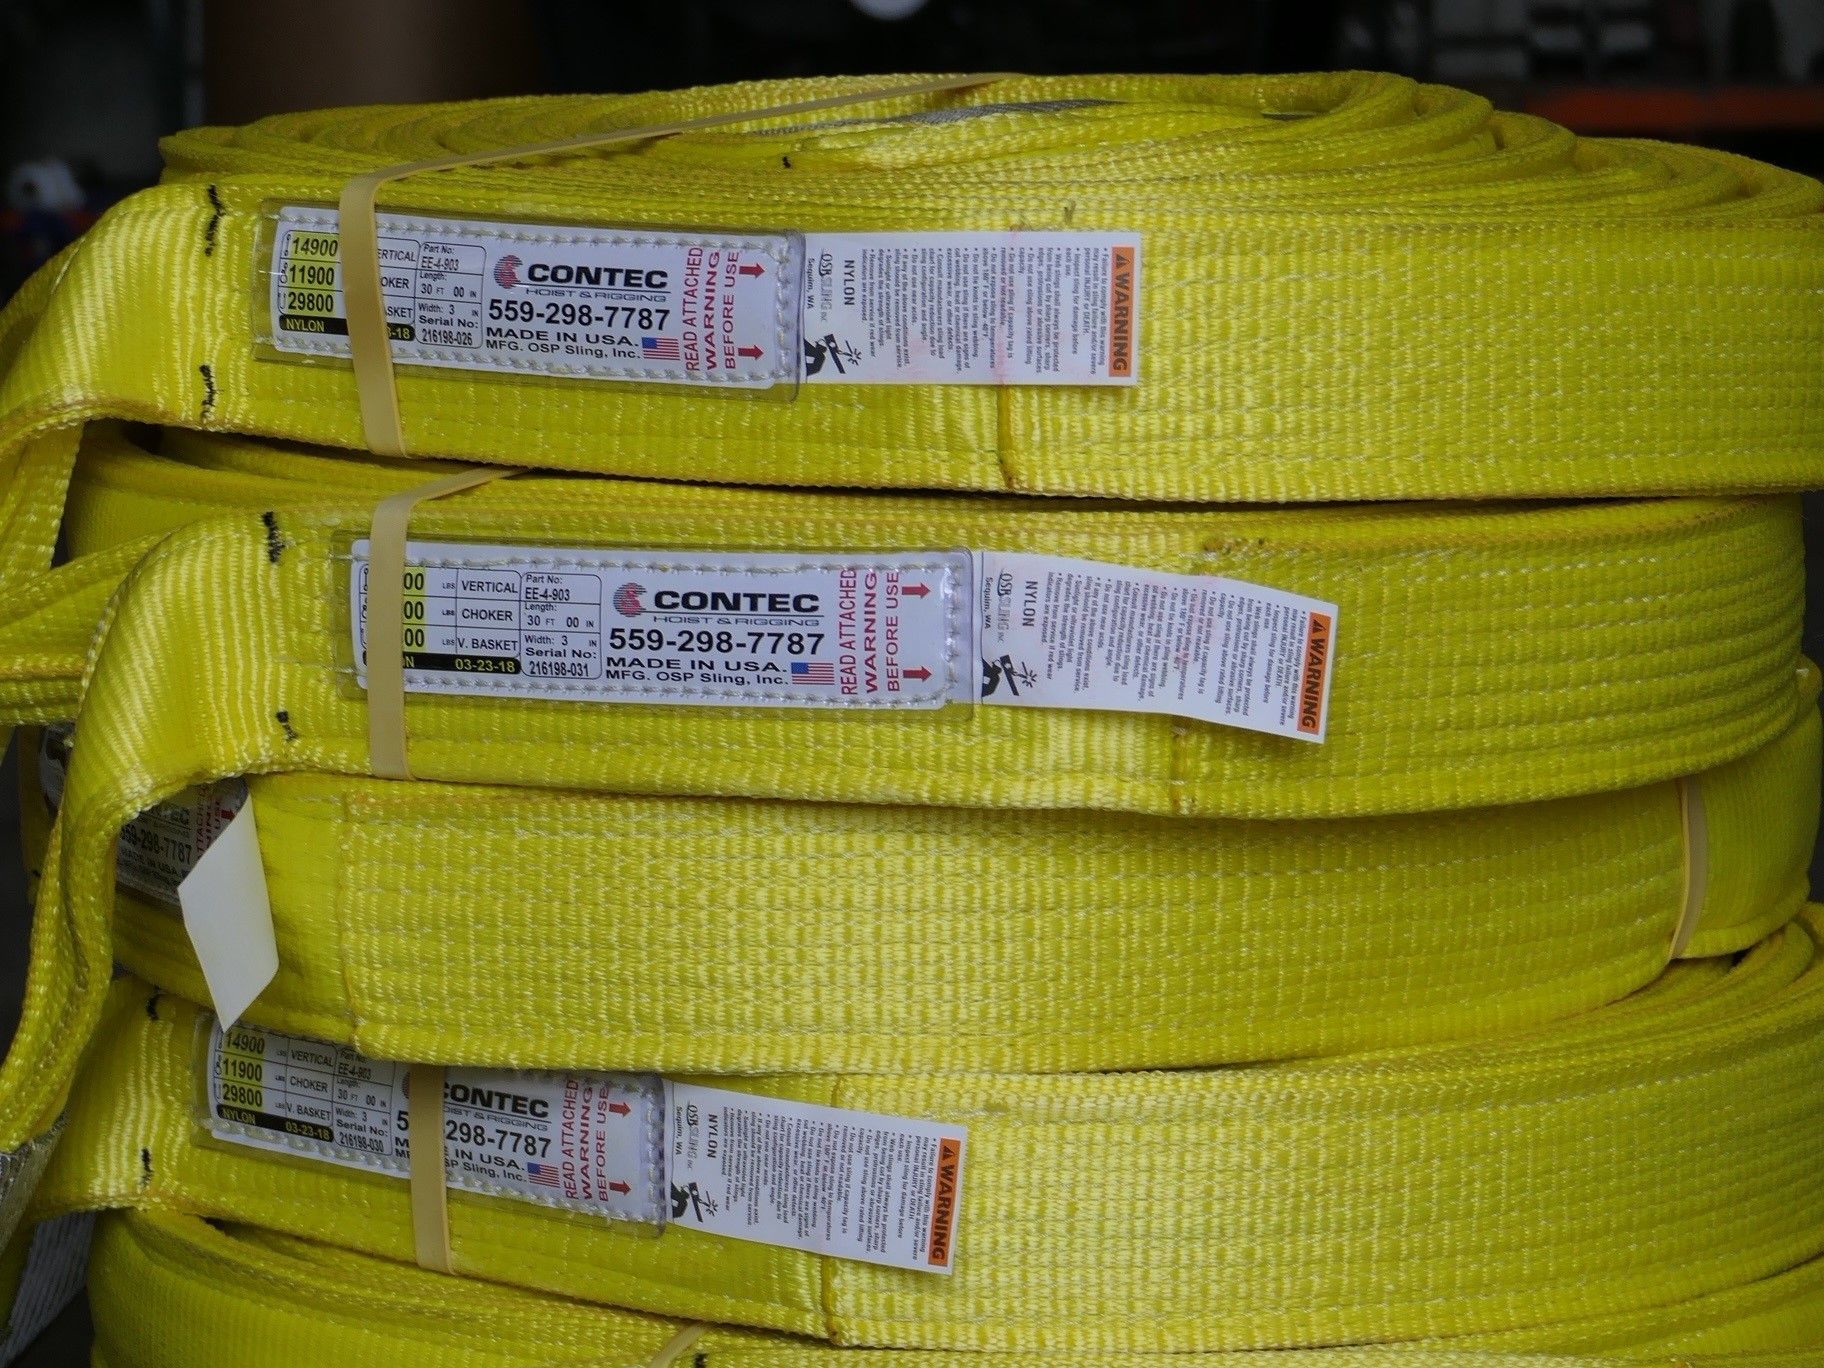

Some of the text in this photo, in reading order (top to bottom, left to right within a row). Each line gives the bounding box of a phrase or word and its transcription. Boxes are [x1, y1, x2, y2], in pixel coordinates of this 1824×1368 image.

[292, 236, 338, 257] 14900
[421, 256, 459, 271] EE-4-903
[289, 264, 334, 286] 11900
[527, 263, 668, 289] CONTEC
[843, 259, 855, 306] NYLON
[288, 292, 334, 312] 29800
[681, 247, 703, 372] READ ATTACHED
[704, 251, 720, 370] WARNING
[722, 251, 739, 369] BEFORE USE
[419, 315, 478, 329] Serial No:
[489, 298, 670, 331] 559-298-7787
[1113, 272, 1132, 371] WARNING
[285, 318, 325, 332] NYLON
[422, 328, 472, 346] 216198-026
[486, 327, 639, 347] MADE IN USA.
[486, 339, 520, 351] MFG.
[528, 341, 560, 354] OSP
[613, 348, 641, 359] Inc.
[461, 580, 518, 594] VERTICAL
[526, 574, 562, 584] Part No:
[525, 587, 570, 601] EE-4-903
[654, 590, 819, 613] CONTEC
[1022, 581, 1037, 627] NYLON
[461, 608, 513, 622] CHOKER
[524, 603, 557, 612] Length:
[527, 614, 579, 628] 30 00
[653, 615, 819, 627] HOIST RIGGING
[838, 567, 858, 695] READ ATTACHED
[524, 634, 554, 645] Width:
[864, 572, 878, 694] WARNING
[886, 571, 900, 692] BEFORE USE
[471, 638, 517, 651] BASKET
[609, 628, 824, 656] 559-298-7787
[526, 647, 597, 659] Serial No:
[455, 658, 516, 672] 03-23-18
[530, 662, 588, 677] 216198-031
[606, 658, 787, 673] MADE IN USA.
[606, 670, 649, 681] MFG.
[656, 671, 693, 682] OSP
[756, 674, 789, 685] Inc.
[1301, 638, 1328, 729] WARNING
[225, 1034, 264, 1055] 14900
[290, 1050, 333, 1067] VERTICAL
[222, 1058, 262, 1082] 11900
[290, 1076, 328, 1093] CHOKER
[222, 1084, 263, 1108] 29800
[222, 1110, 256, 1126] NYLON
[296, 1102, 331, 1121] BASKET
[285, 1121, 330, 1141] 03-23-18
[336, 1119, 388, 1136] Serial No:
[707, 1114, 718, 1158] NYLON
[339, 1132, 384, 1152] 216198-030
[561, 1078, 578, 1200] READ ATTACHED
[579, 1085, 593, 1200] WARNING
[596, 1086, 609, 1201] BEFORE USE
[481, 1154, 525, 1171] USA.
[932, 1160, 954, 1260] WARNING
